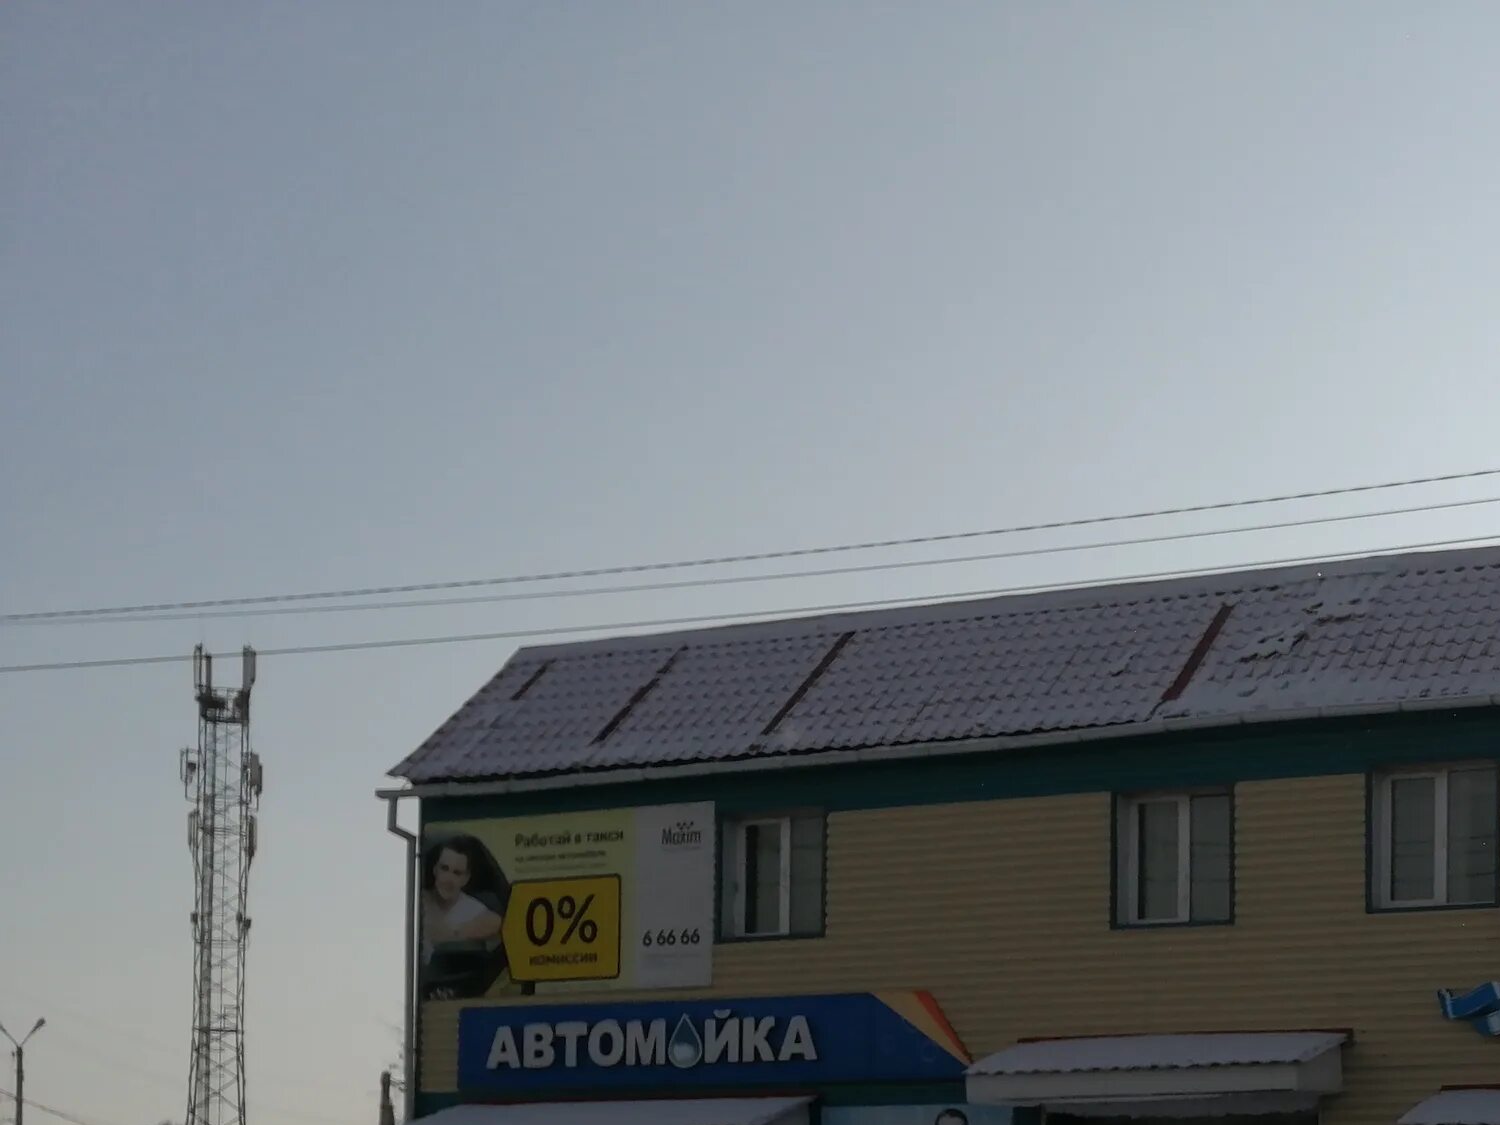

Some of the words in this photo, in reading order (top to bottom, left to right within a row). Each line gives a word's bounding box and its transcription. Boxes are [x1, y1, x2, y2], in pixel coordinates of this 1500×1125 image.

[515, 832, 571, 847] Работай
[526, 894, 597, 946] 0%
[643, 930, 652, 946] 6
[657, 929, 676, 945] 66
[681, 928, 700, 944] 66
[486, 1008, 818, 1069] АВТОМОЙКА
